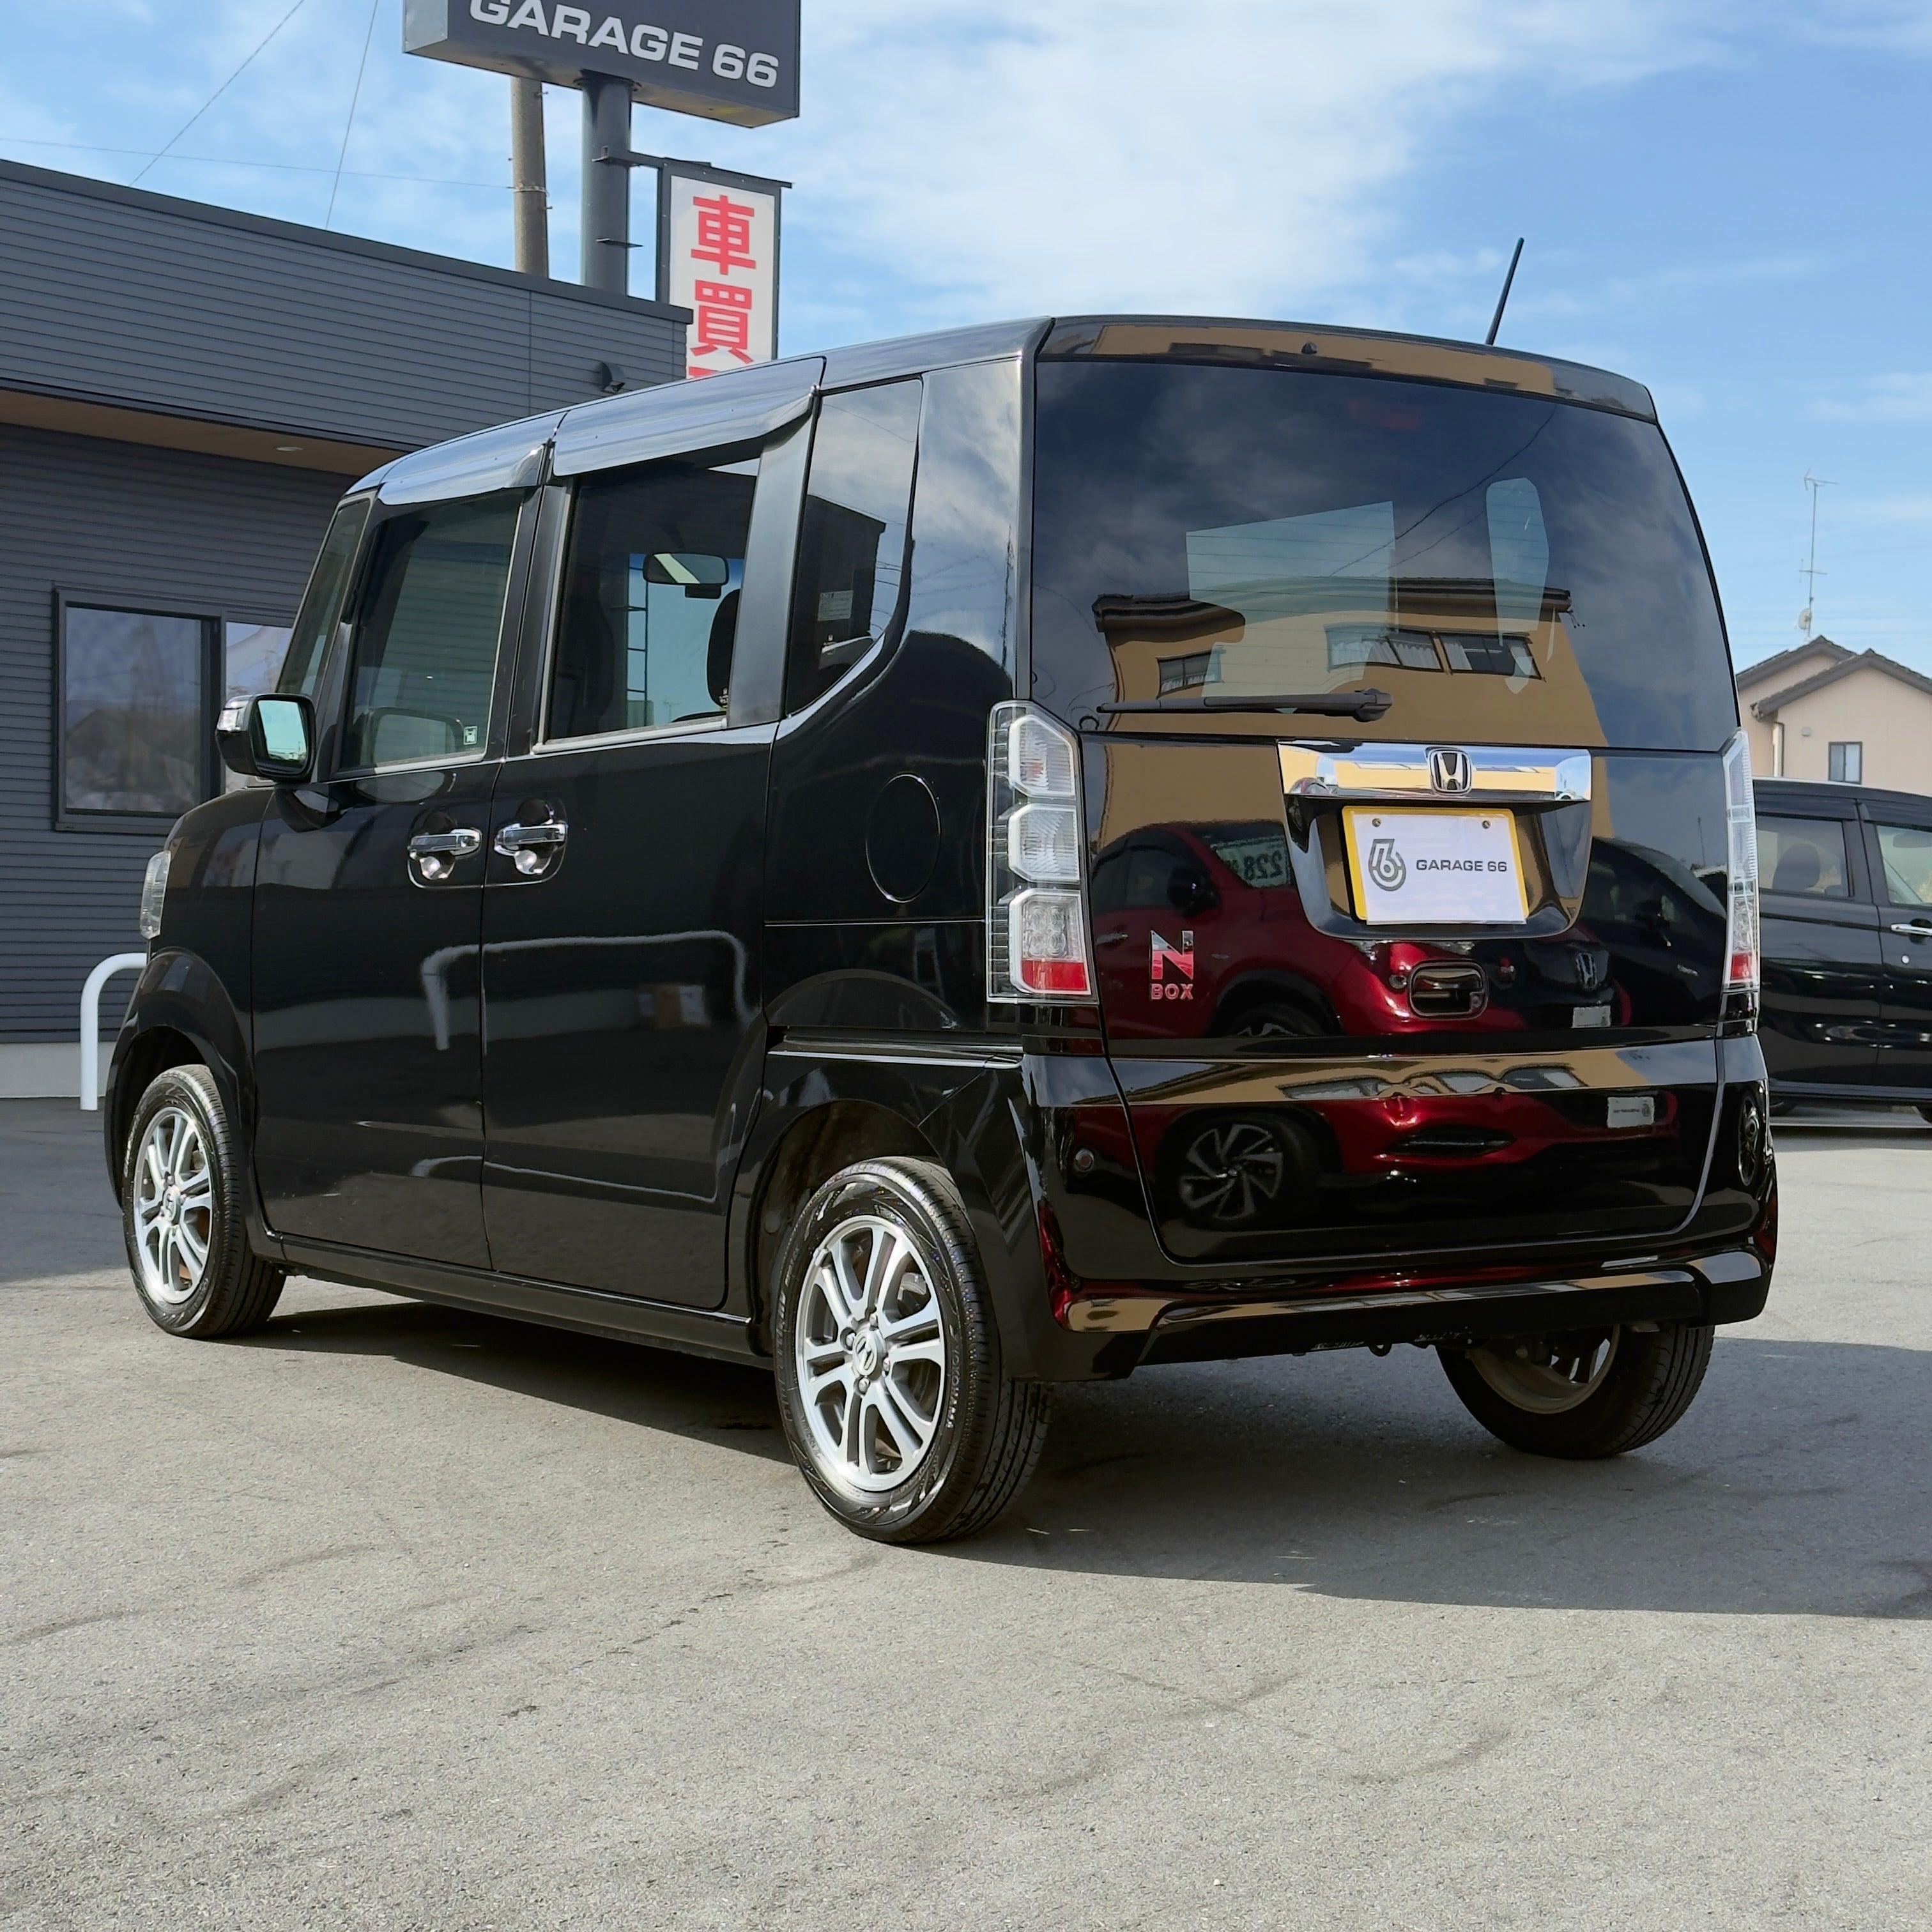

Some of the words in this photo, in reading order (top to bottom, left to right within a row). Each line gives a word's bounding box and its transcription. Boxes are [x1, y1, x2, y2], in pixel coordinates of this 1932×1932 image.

[470, 0, 703, 70] GARAGE
[712, 44, 778, 88] 66
[688, 195, 756, 379] 車買
[1416, 859, 1483, 871] GARAGE
[1488, 861, 1507, 872] 66
[1151, 930, 1193, 979] N
[1151, 983, 1193, 1000] BOX
[947, 1345, 960, 1429] YOKOHAMA
